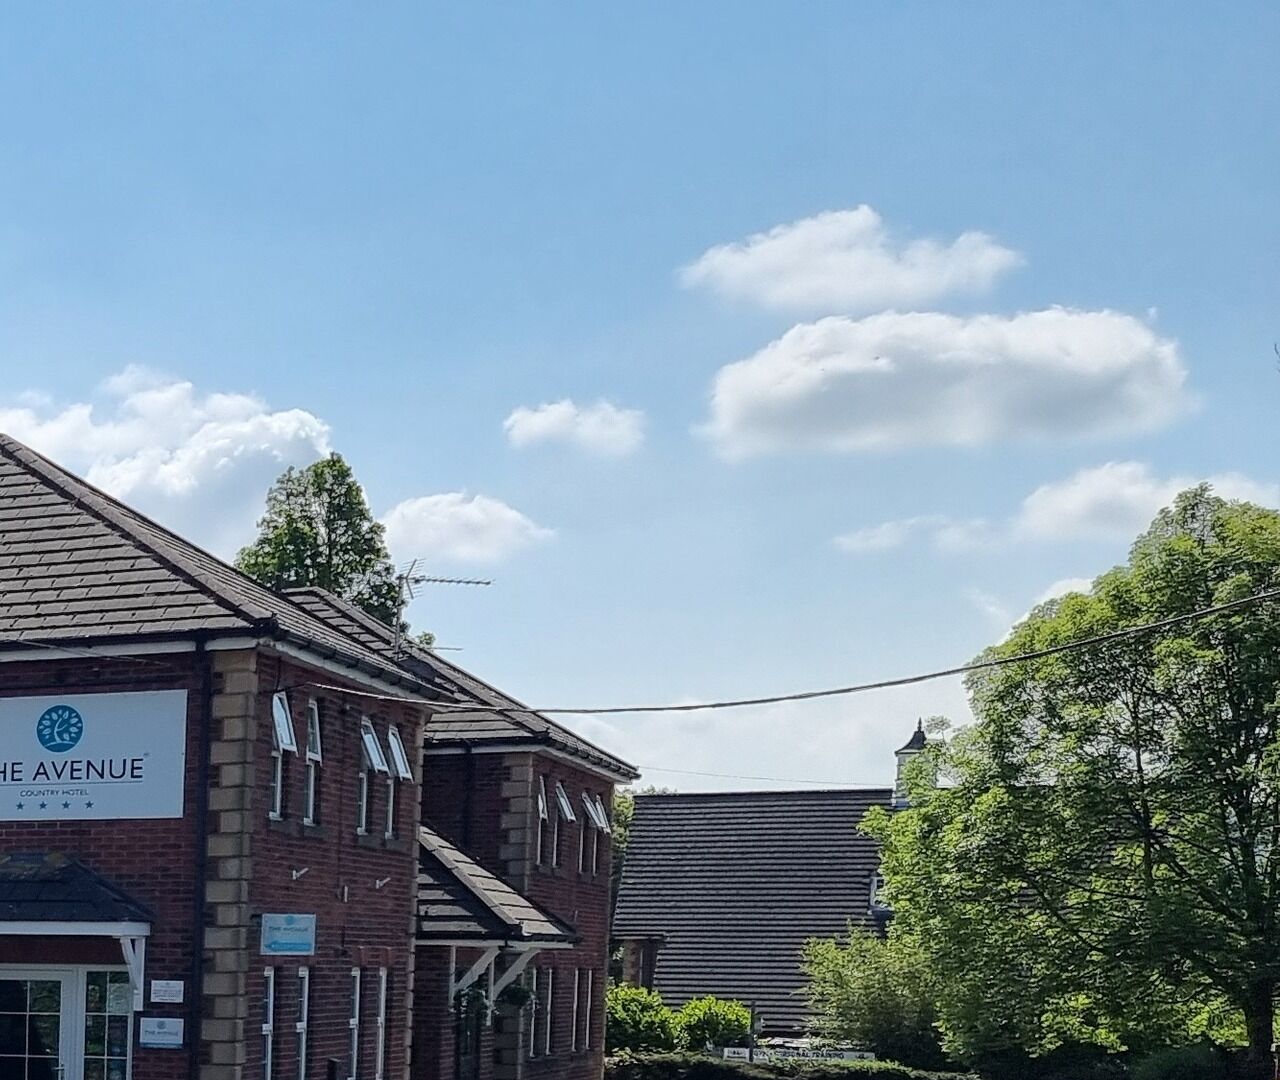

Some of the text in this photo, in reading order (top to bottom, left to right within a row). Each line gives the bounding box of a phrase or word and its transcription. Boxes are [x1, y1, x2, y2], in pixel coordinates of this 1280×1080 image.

[32, 758, 145, 782] AVENUE
[20, 788, 89, 797] COUNTRY HOTEL
